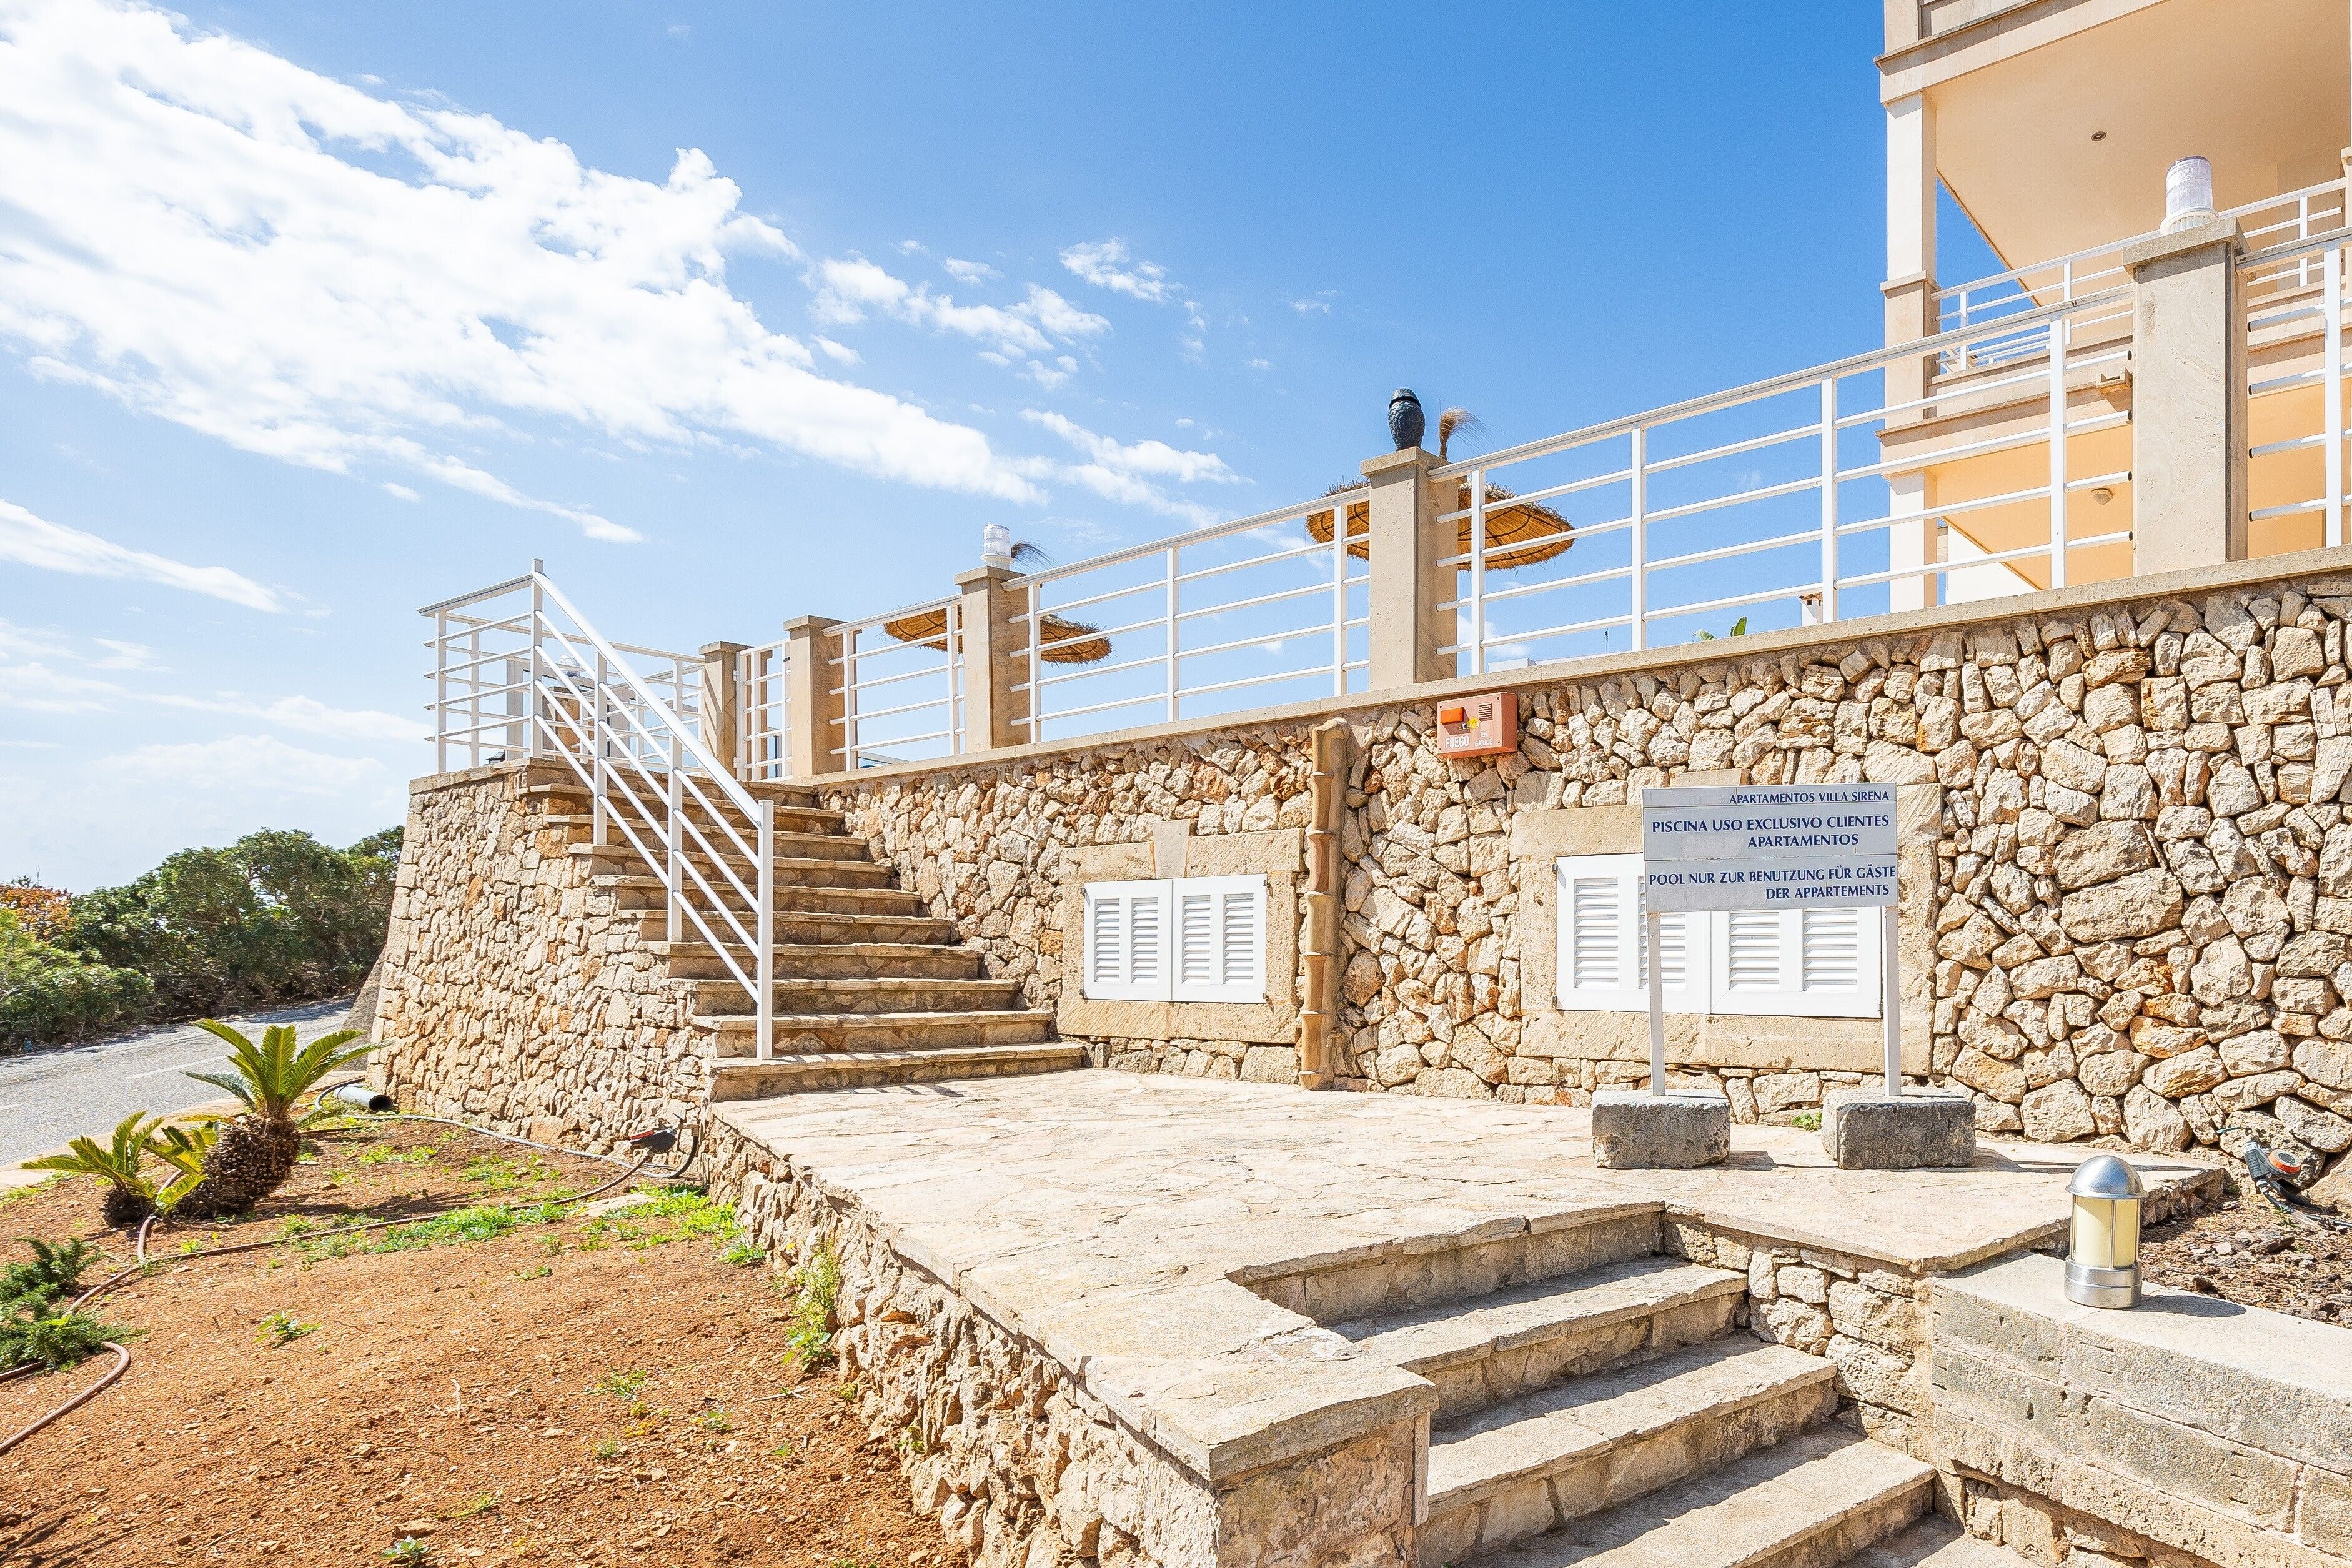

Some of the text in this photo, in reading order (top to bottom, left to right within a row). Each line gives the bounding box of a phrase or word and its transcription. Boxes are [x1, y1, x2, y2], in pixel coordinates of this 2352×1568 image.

[1446, 735, 1470, 748] FUEGO
[1474, 738, 1494, 747] GARAJE
[1729, 790, 1889, 804] APARTAMENTOS VILLA SIRENA
[1652, 815, 1889, 832] PISCINA USO EXCLUSIVO CLIENTES
[1748, 833, 1859, 847] APARTAMENTOS
[1650, 864, 1896, 885] POOL NUR ZUR BENUTZUNG FÜR GÄSTE
[1766, 884, 1889, 899] DER APPARTEMENTS
